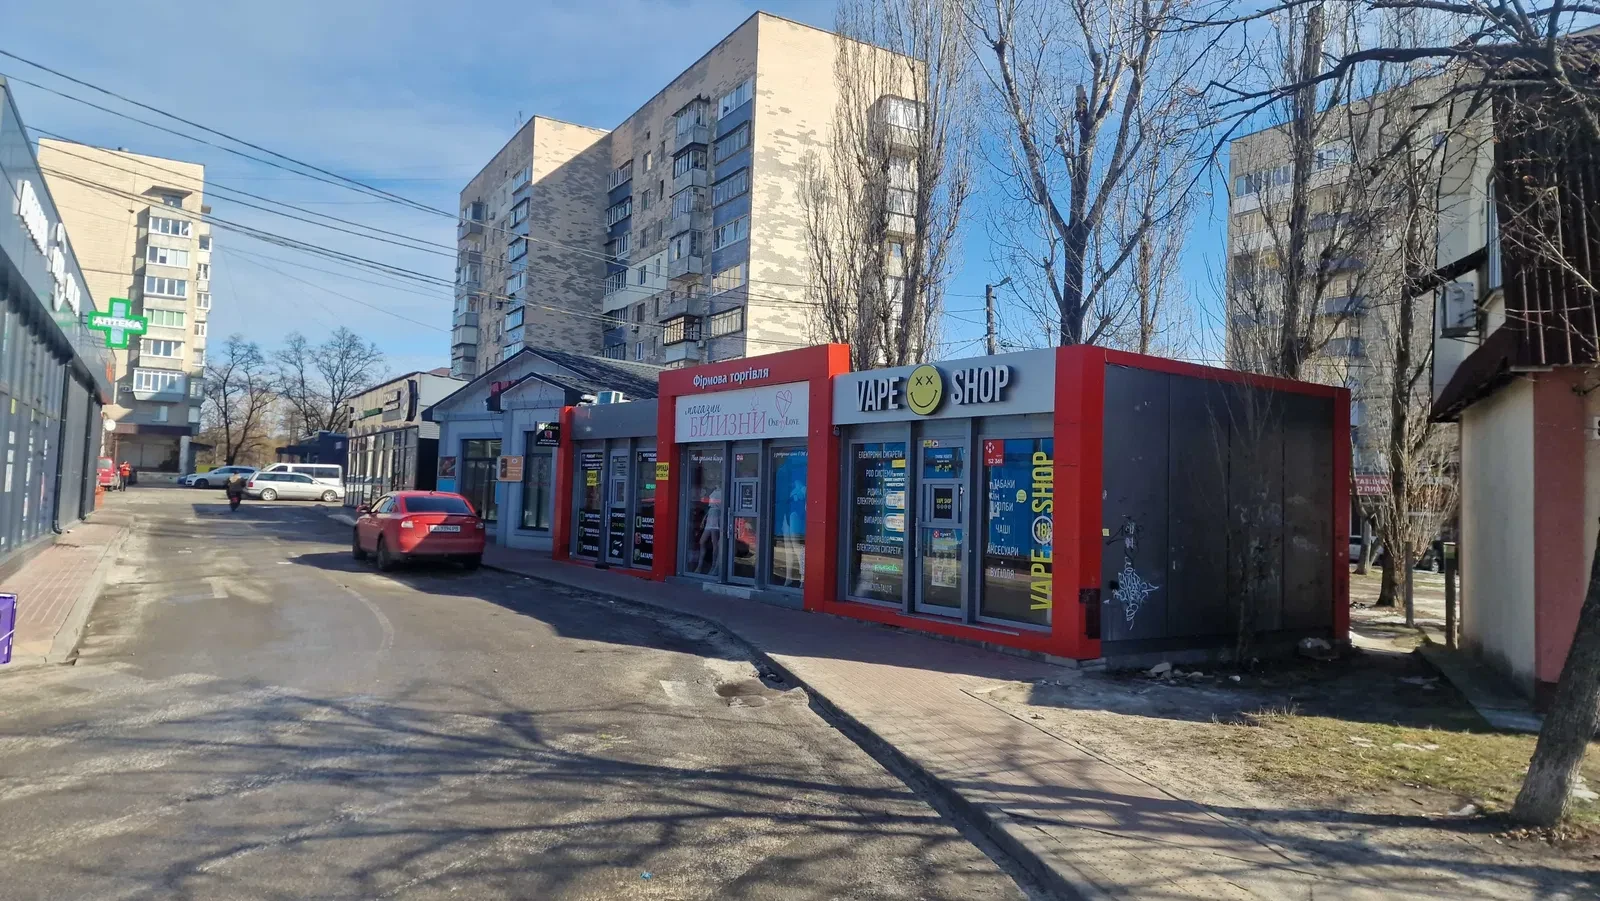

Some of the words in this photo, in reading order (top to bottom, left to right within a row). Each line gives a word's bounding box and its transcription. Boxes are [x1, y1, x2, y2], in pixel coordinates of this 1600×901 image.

[94, 316, 142, 329] АПТЕКА
[693, 374, 728, 389] Фірмова
[730, 367, 769, 384] торгівля
[857, 376, 901, 412] VAPE
[951, 364, 1008, 405] SHOP
[685, 404, 722, 422] магазин
[1032, 451, 1054, 514] SHOP
[1031, 549, 1053, 610] VAPE
